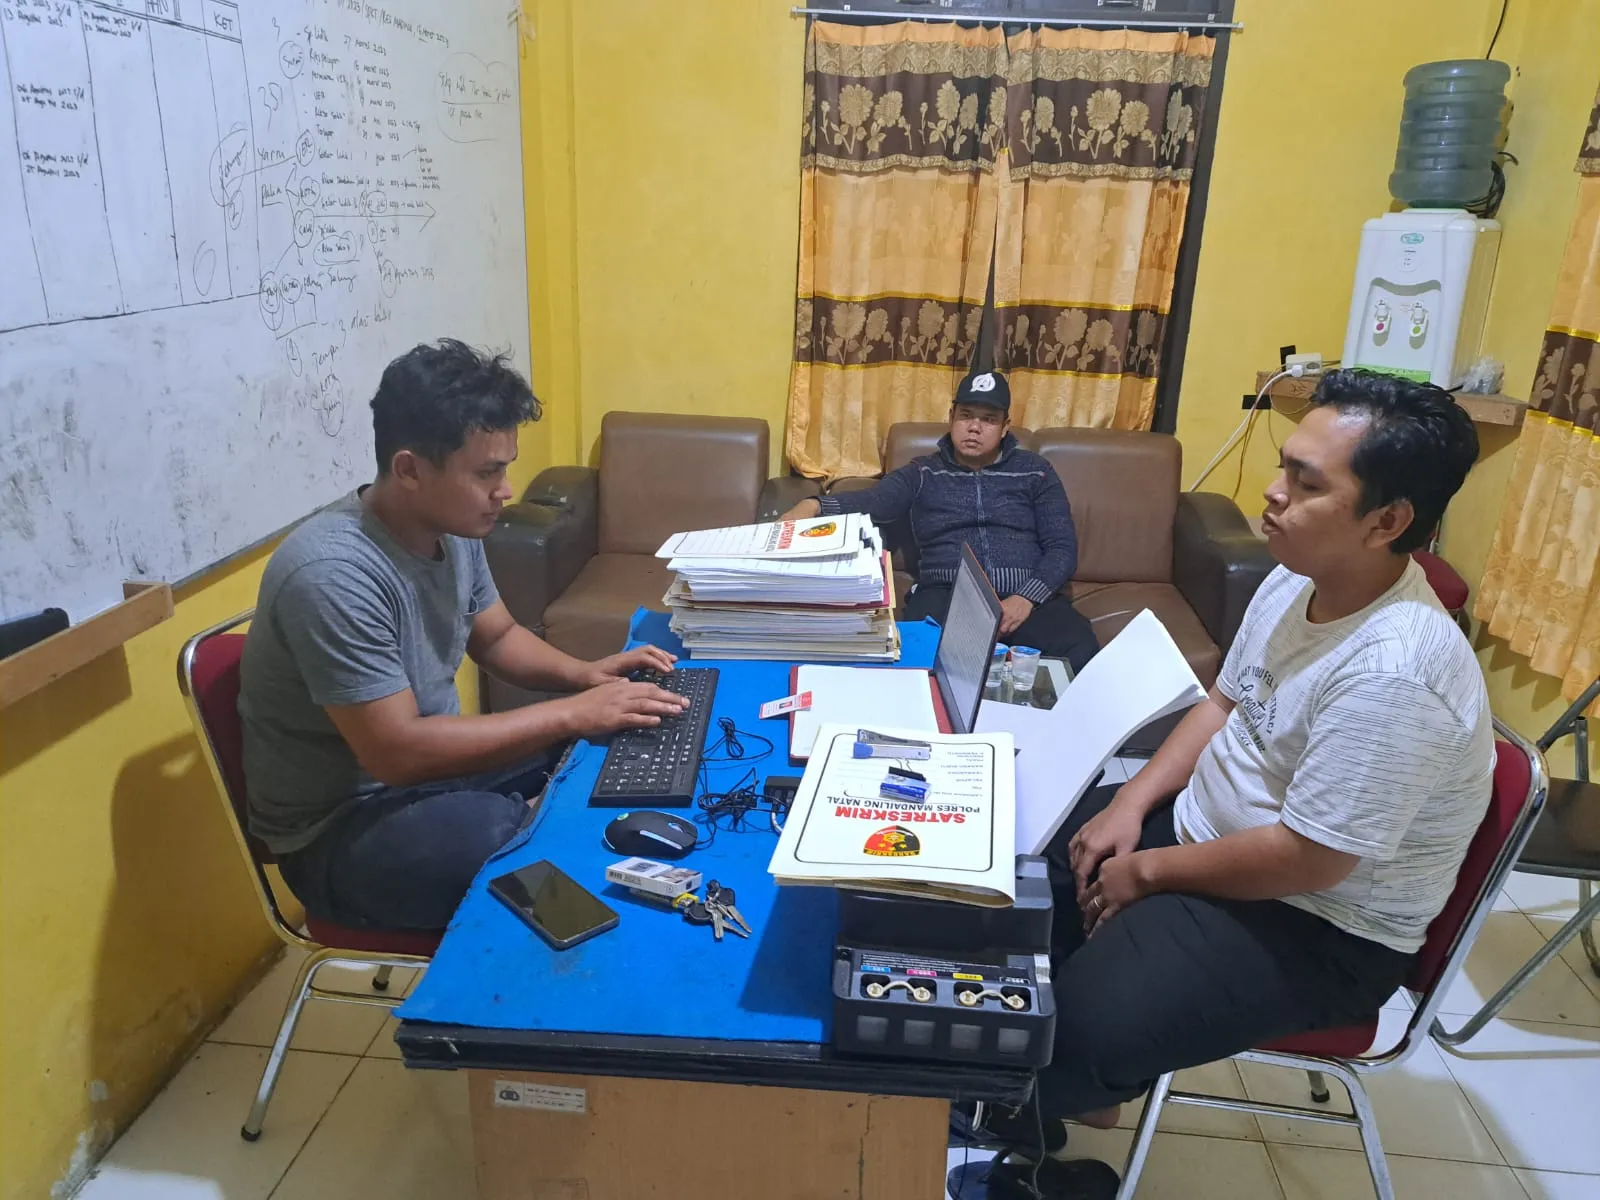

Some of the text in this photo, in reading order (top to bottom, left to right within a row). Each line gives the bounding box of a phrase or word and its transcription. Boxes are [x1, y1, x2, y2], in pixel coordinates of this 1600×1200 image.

[213, 11, 233, 32] KET
[826, 795, 980, 814] POLRES MANDAILING NATAL
[834, 805, 967, 824] SATRESKRIM
